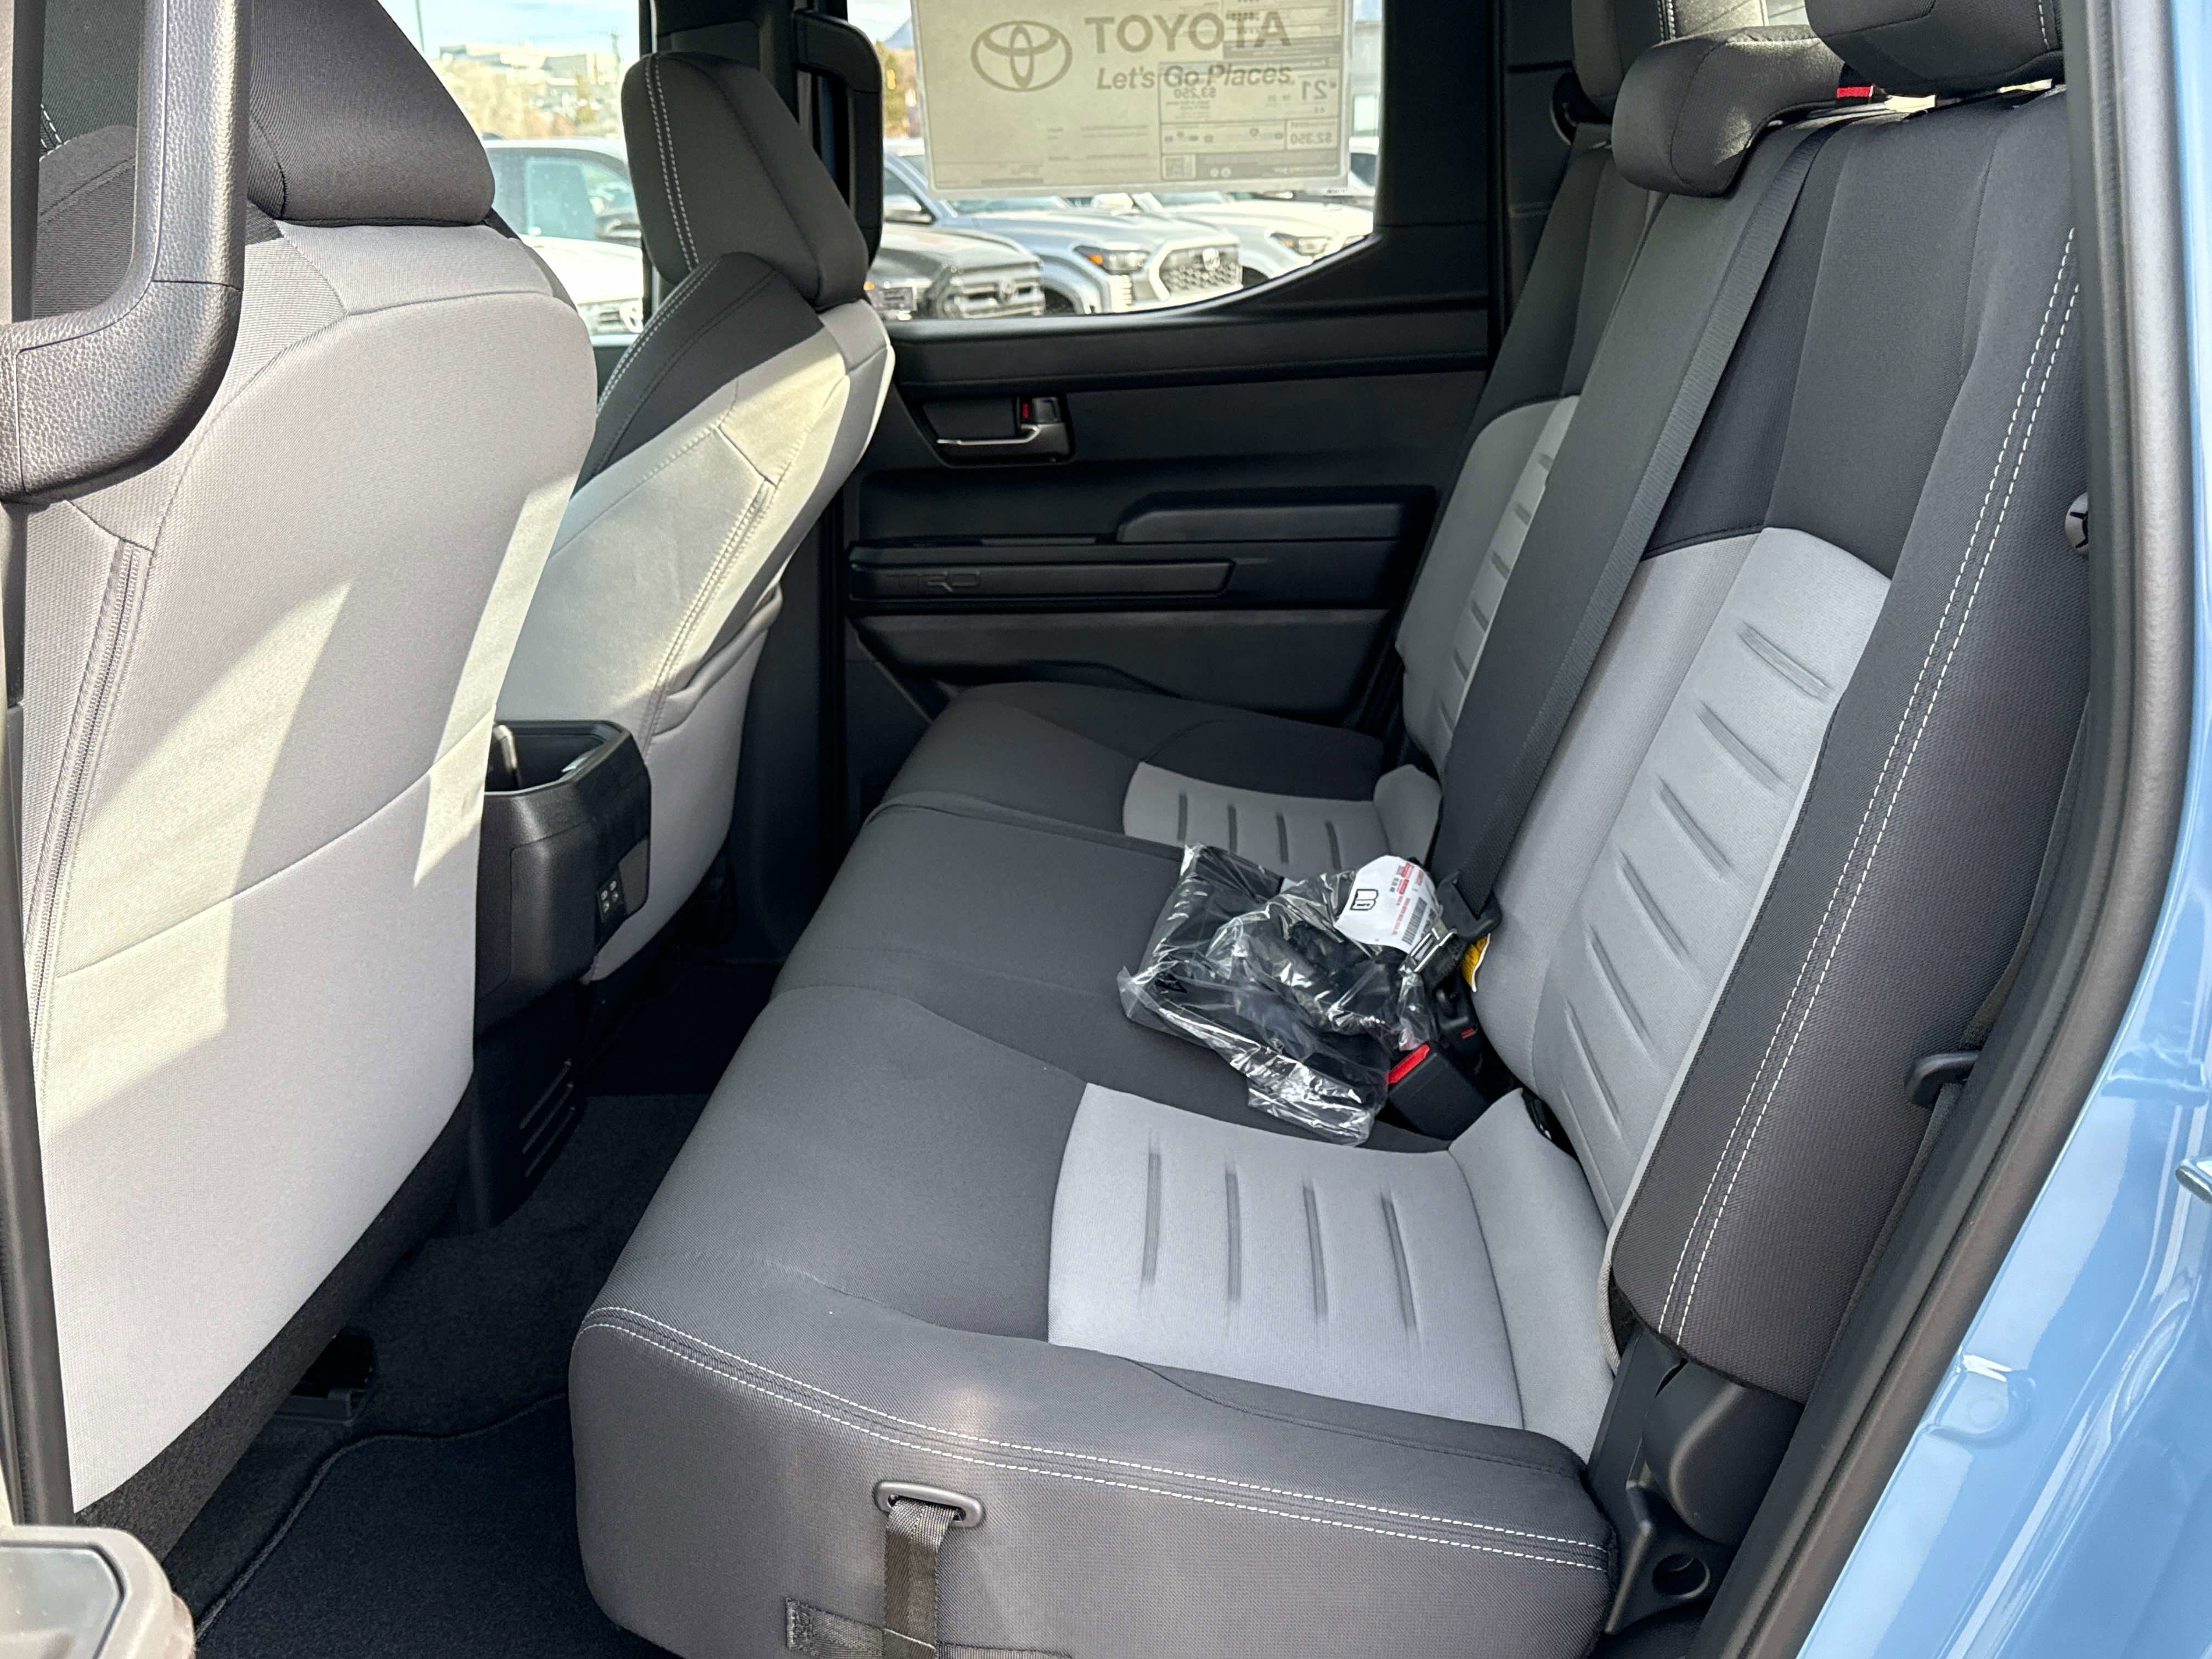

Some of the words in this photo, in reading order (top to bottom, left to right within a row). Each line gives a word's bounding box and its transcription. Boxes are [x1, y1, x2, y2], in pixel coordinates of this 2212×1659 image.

[1085, 12, 1290, 53] TOYOTA
[1097, 66, 1155, 89] Let's
[1164, 65, 1200, 87] Go
